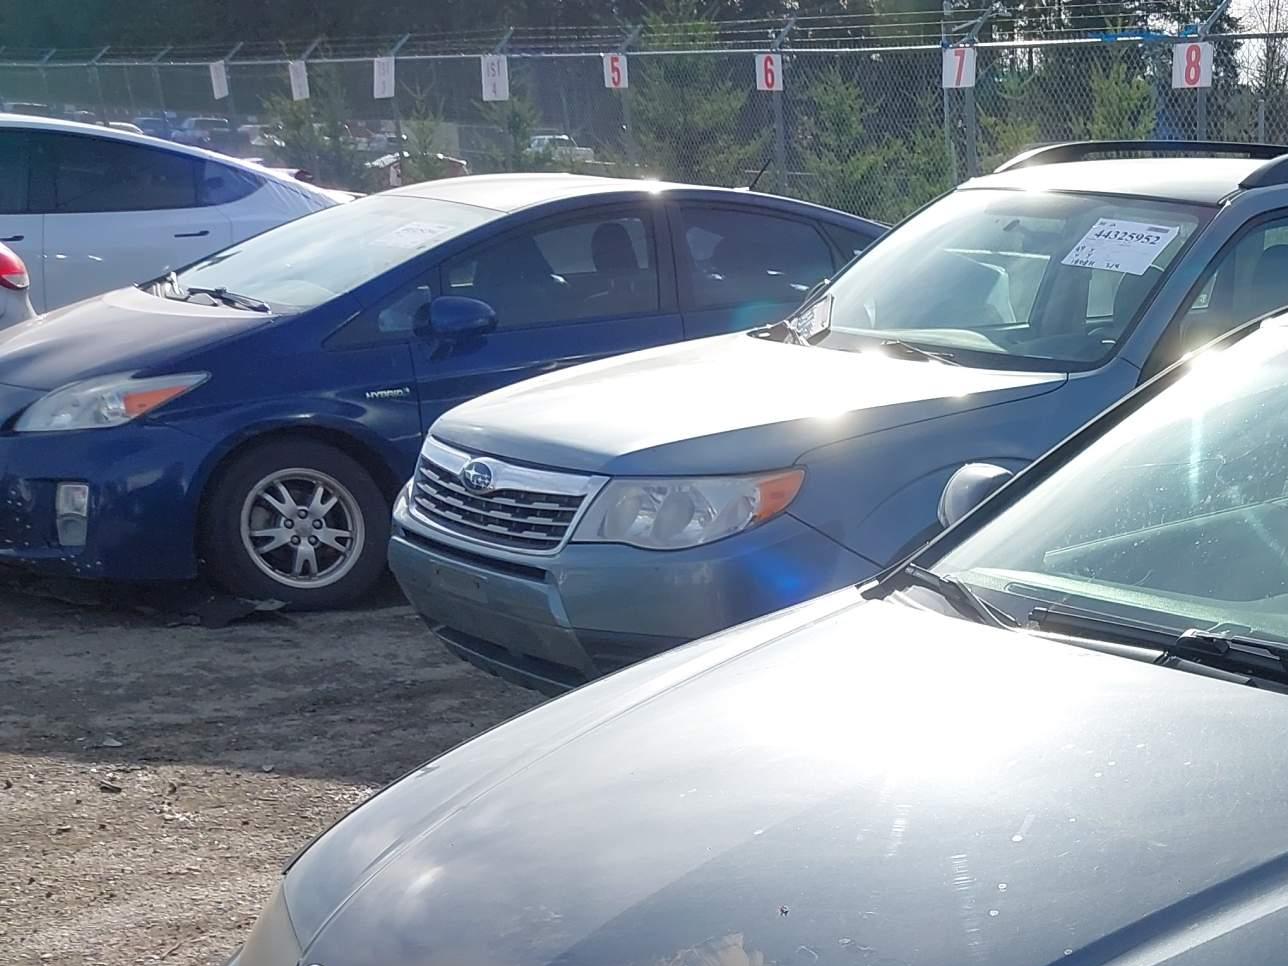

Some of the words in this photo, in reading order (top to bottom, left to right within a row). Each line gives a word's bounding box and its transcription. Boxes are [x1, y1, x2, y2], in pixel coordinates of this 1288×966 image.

[610, 56, 621, 87] 5
[764, 55, 774, 88] 6
[955, 49, 965, 86] 7
[1184, 44, 1200, 85] 8
[1094, 229, 1162, 245] 44325952
